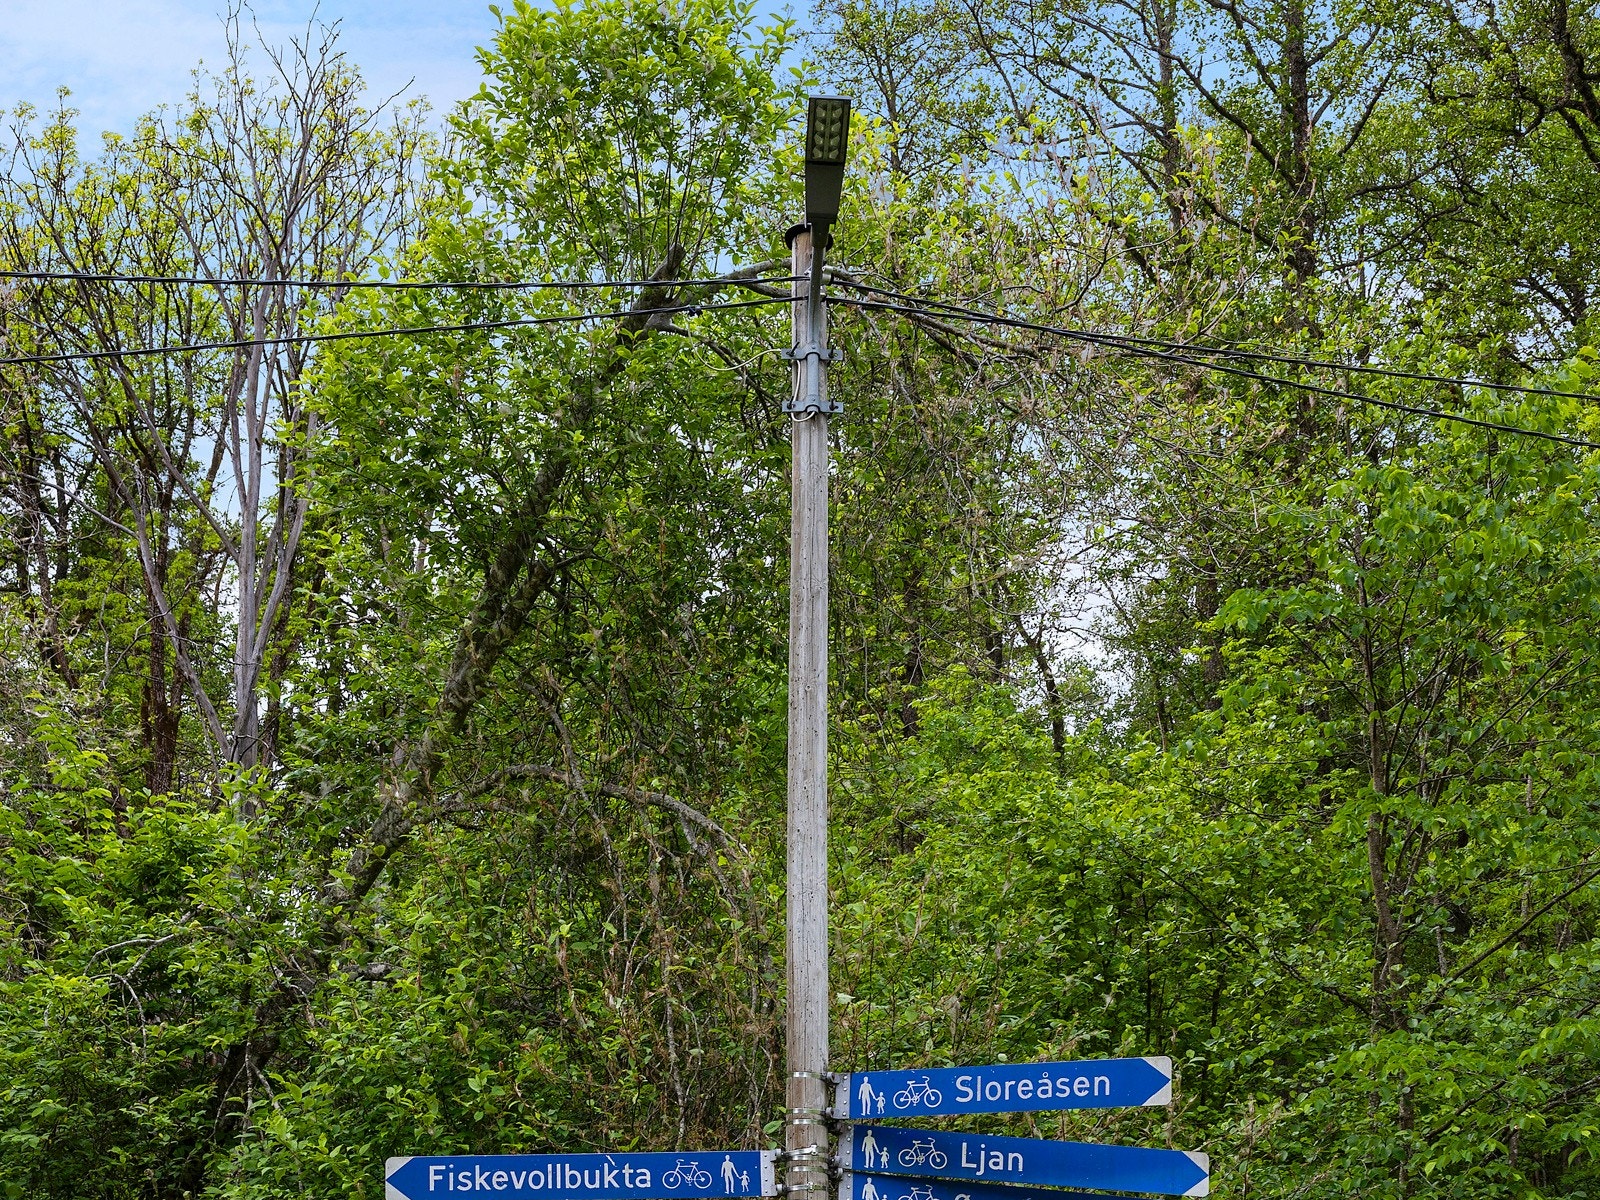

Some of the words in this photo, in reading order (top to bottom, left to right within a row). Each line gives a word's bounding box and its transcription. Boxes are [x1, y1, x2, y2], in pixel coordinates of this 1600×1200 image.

[955, 1072, 1110, 1103] Sloreåsen
[961, 1143, 1024, 1176] Ljan
[429, 1162, 651, 1191] Fiskevollbukta
